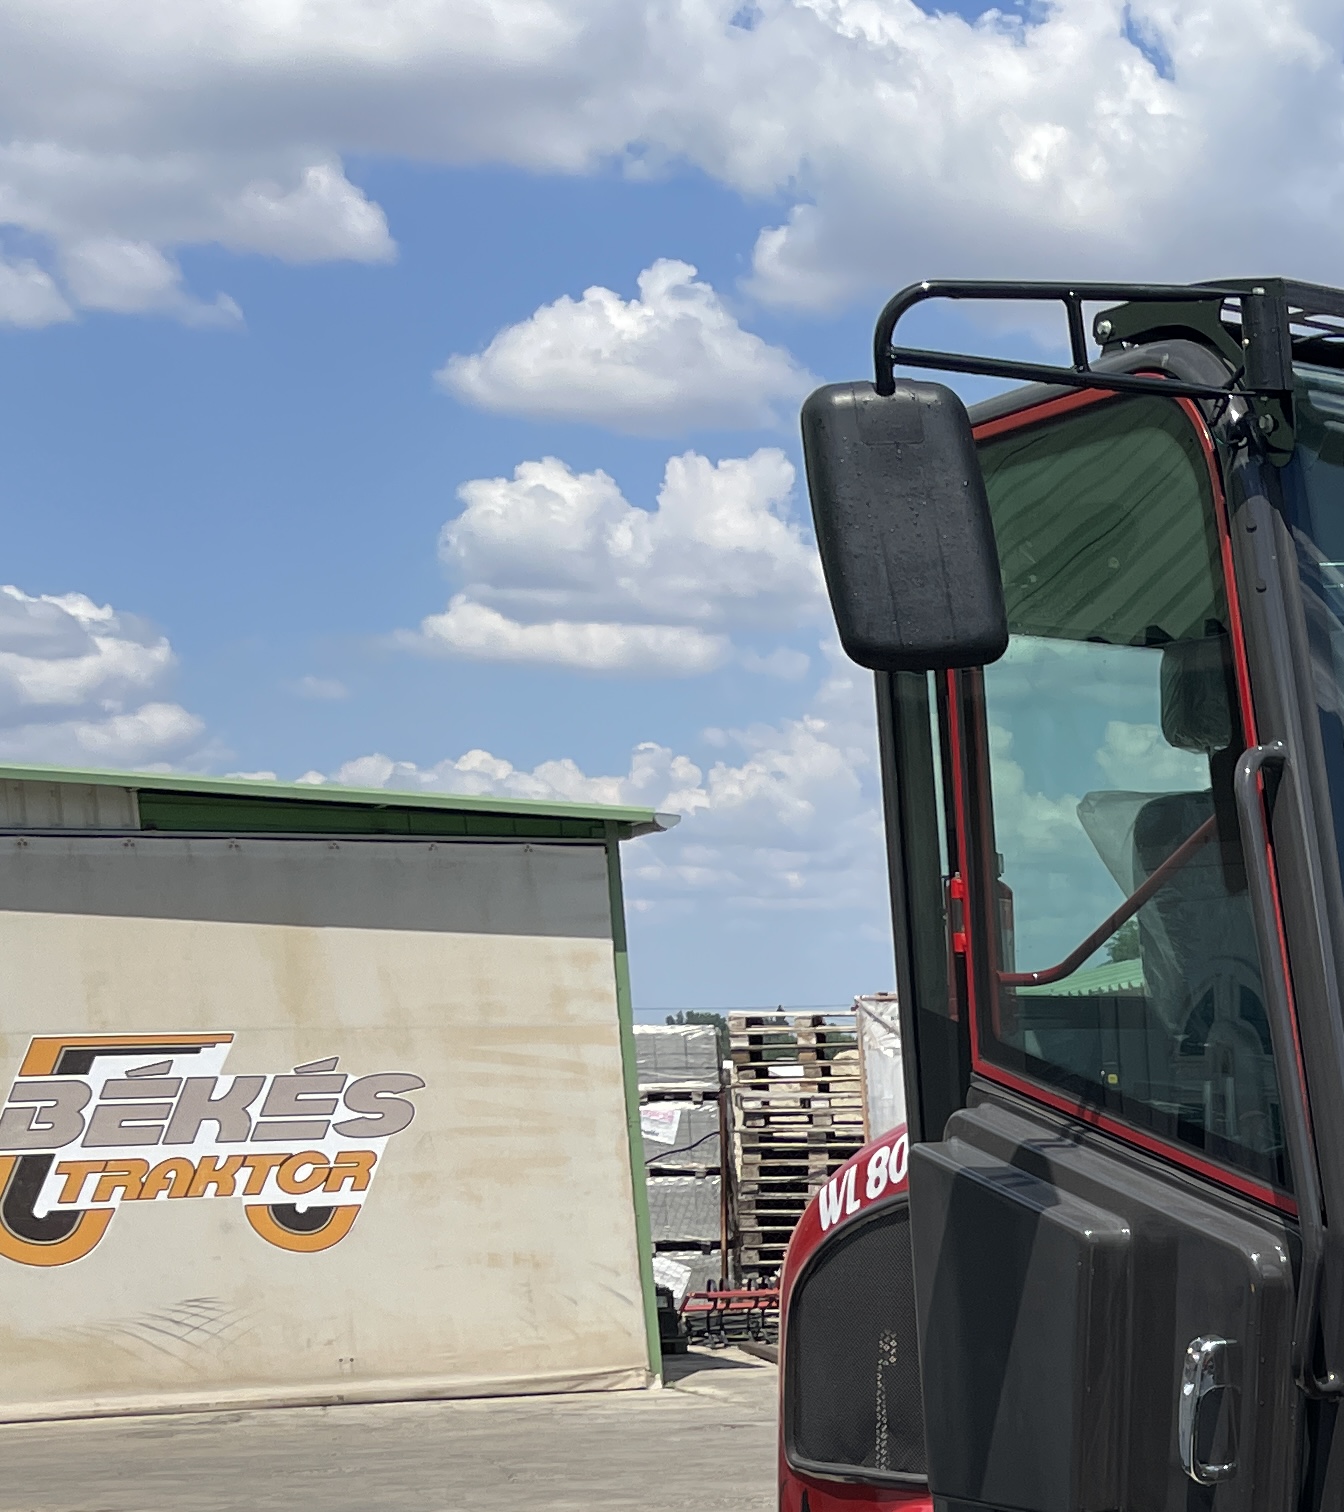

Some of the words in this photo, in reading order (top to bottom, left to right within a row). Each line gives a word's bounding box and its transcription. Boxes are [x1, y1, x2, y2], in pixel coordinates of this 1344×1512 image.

[0, 1056, 427, 1151] BÉKÉS
[55, 1150, 378, 1204] TRAKTOR
[819, 1164, 860, 1231] WL
[866, 1132, 909, 1199] 80
